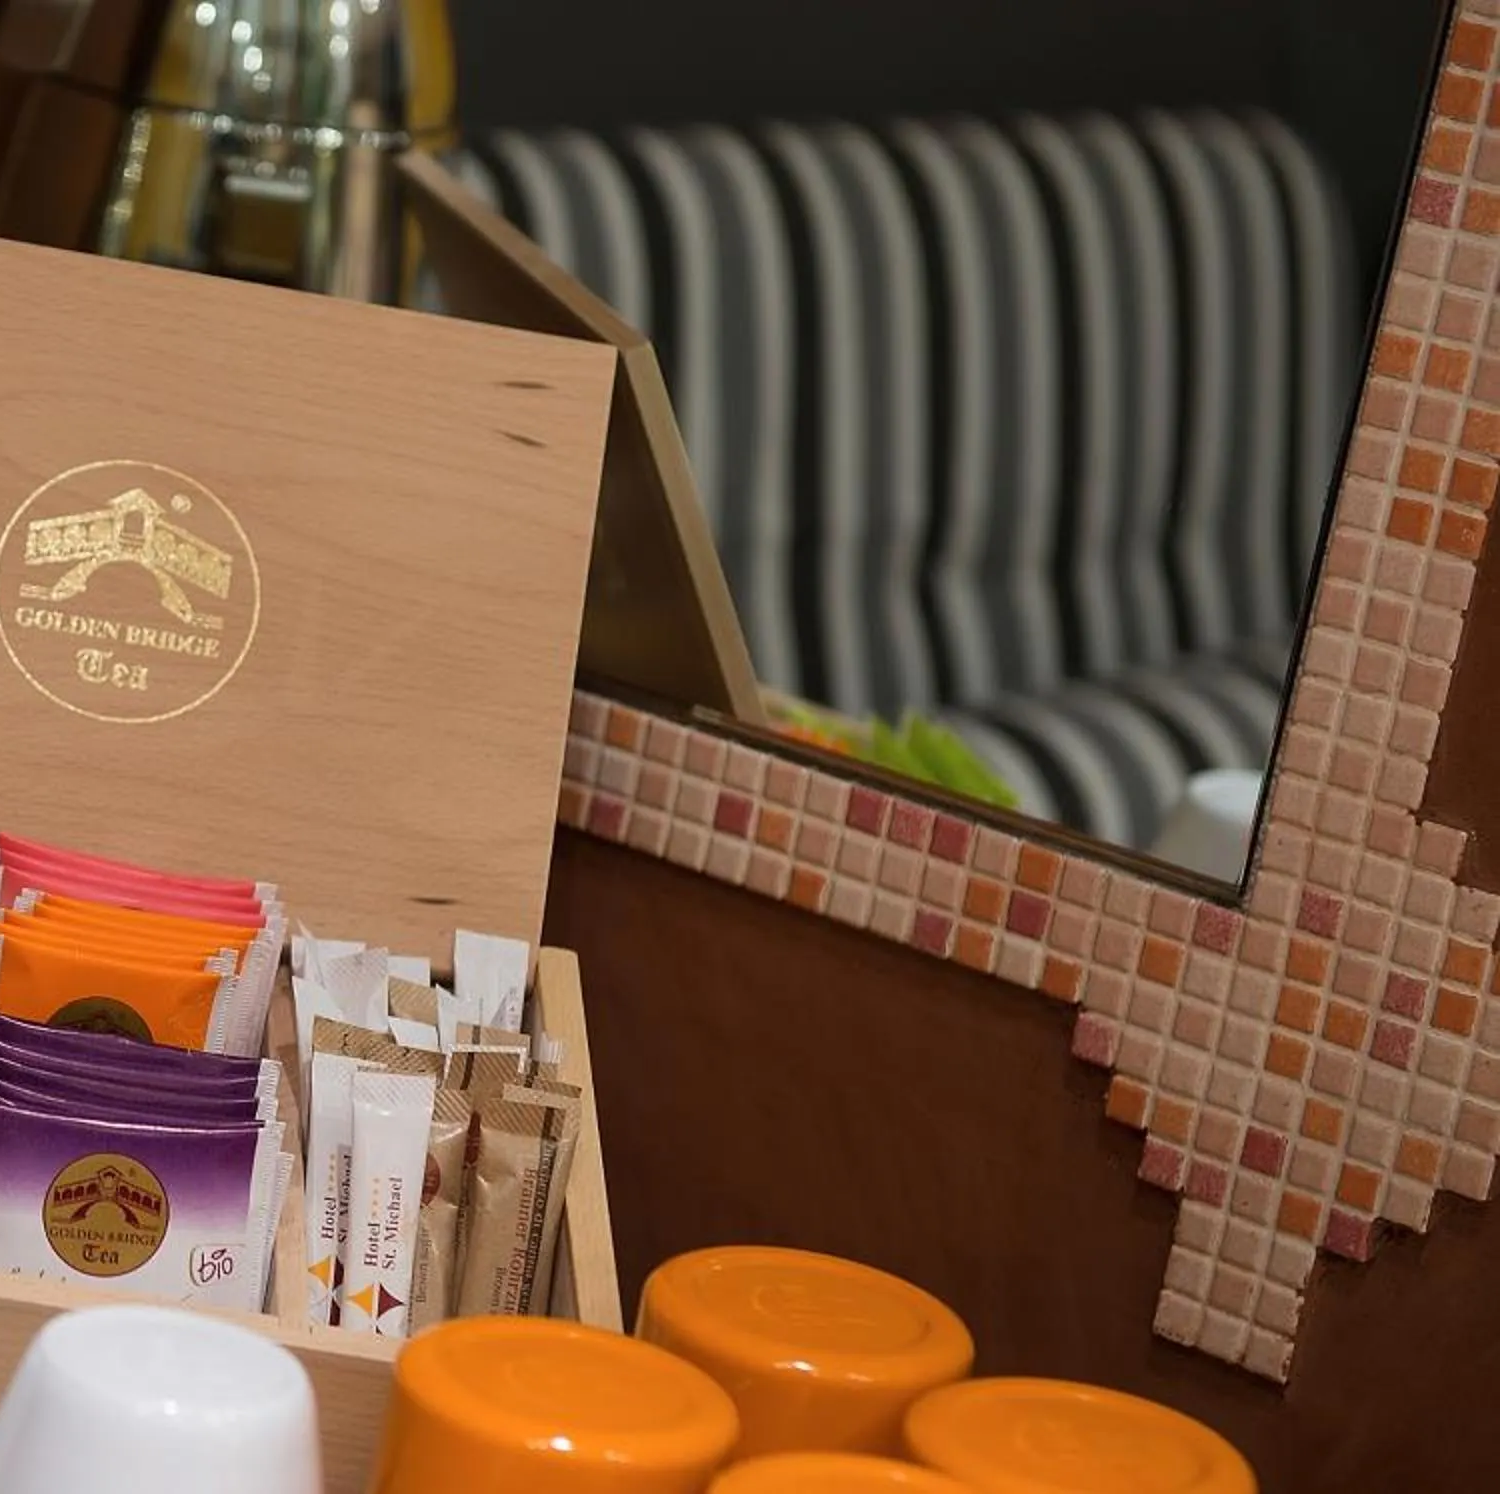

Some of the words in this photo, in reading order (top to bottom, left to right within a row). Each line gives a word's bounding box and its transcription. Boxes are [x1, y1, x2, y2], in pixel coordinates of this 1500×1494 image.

[14, 606, 118, 641] GOLDEN
[125, 627, 221, 658] BRIDGE
[75, 648, 149, 690] Tea
[320, 1197, 337, 1240] Hotel
[383, 1176, 403, 1243] Michael
[49, 1225, 105, 1241] GOLDEN
[106, 1231, 160, 1248] BRIDGE
[81, 1243, 120, 1266] Tea
[363, 1222, 381, 1267] Hotel
[197, 1248, 235, 1283] bio
[381, 1248, 398, 1271] St.
[504, 1247, 525, 1316] Rohrzu
